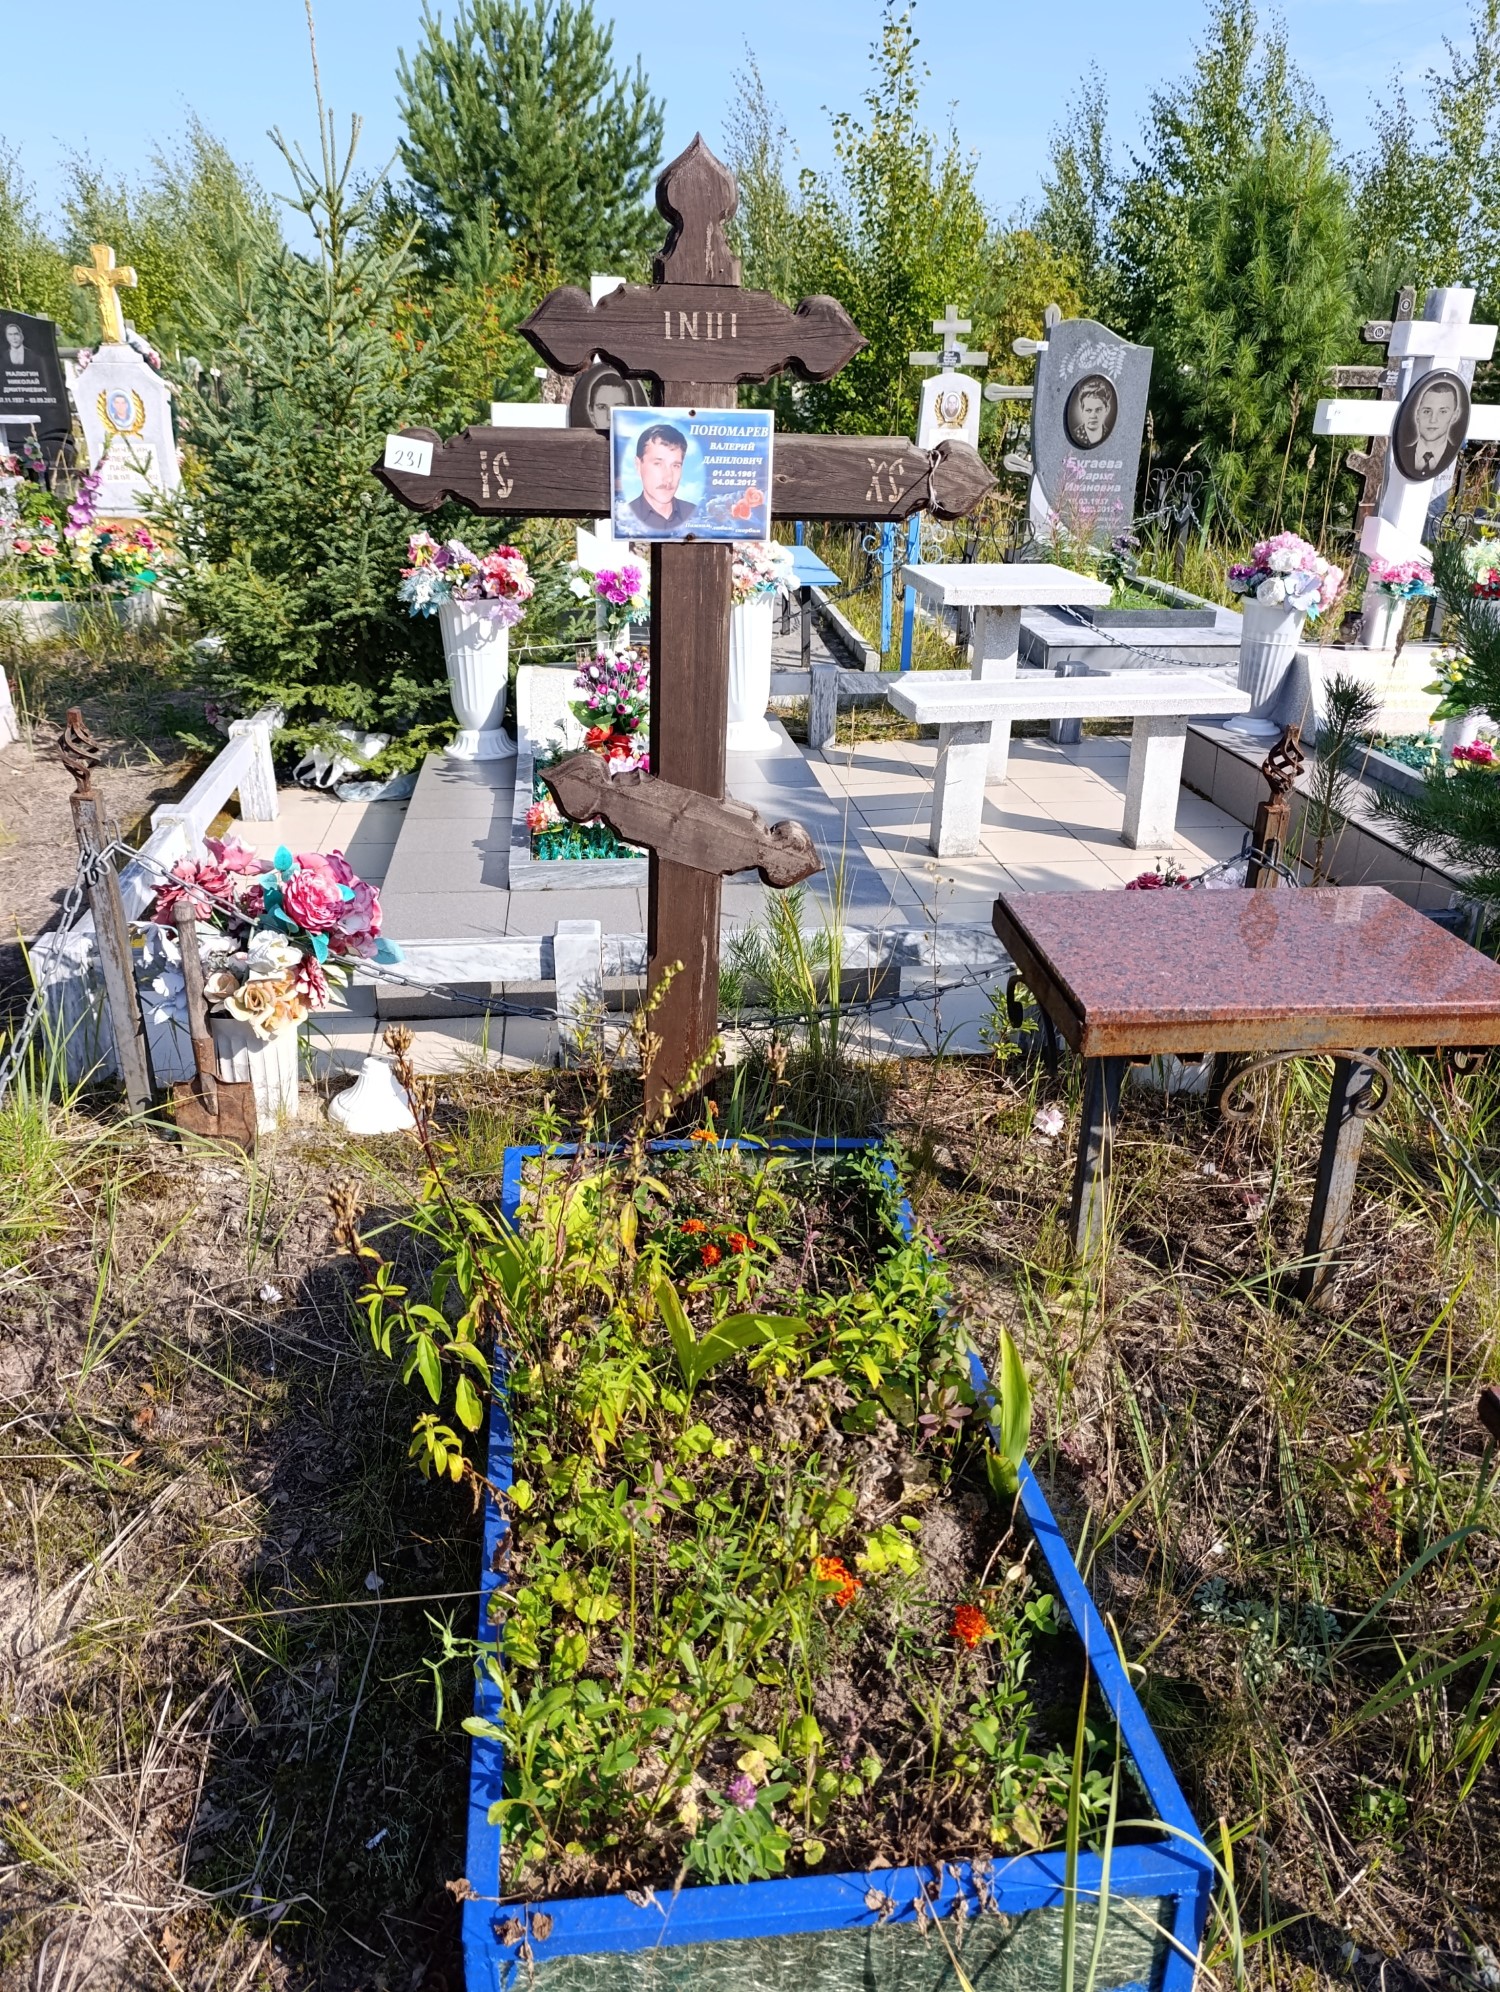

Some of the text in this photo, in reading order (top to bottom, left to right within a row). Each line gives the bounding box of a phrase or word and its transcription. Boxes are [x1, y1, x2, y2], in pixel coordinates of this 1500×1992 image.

[689, 424, 769, 437] ПОНОМАРЕВ
[709, 442, 755, 451] ВАЛЕРИЙ
[393, 450, 423, 469] 231
[702, 455, 763, 465] ДАНИЛОВИЧ
[1066, 457, 1123, 470] Бугаева
[1064, 482, 1121, 492] Ивановна
